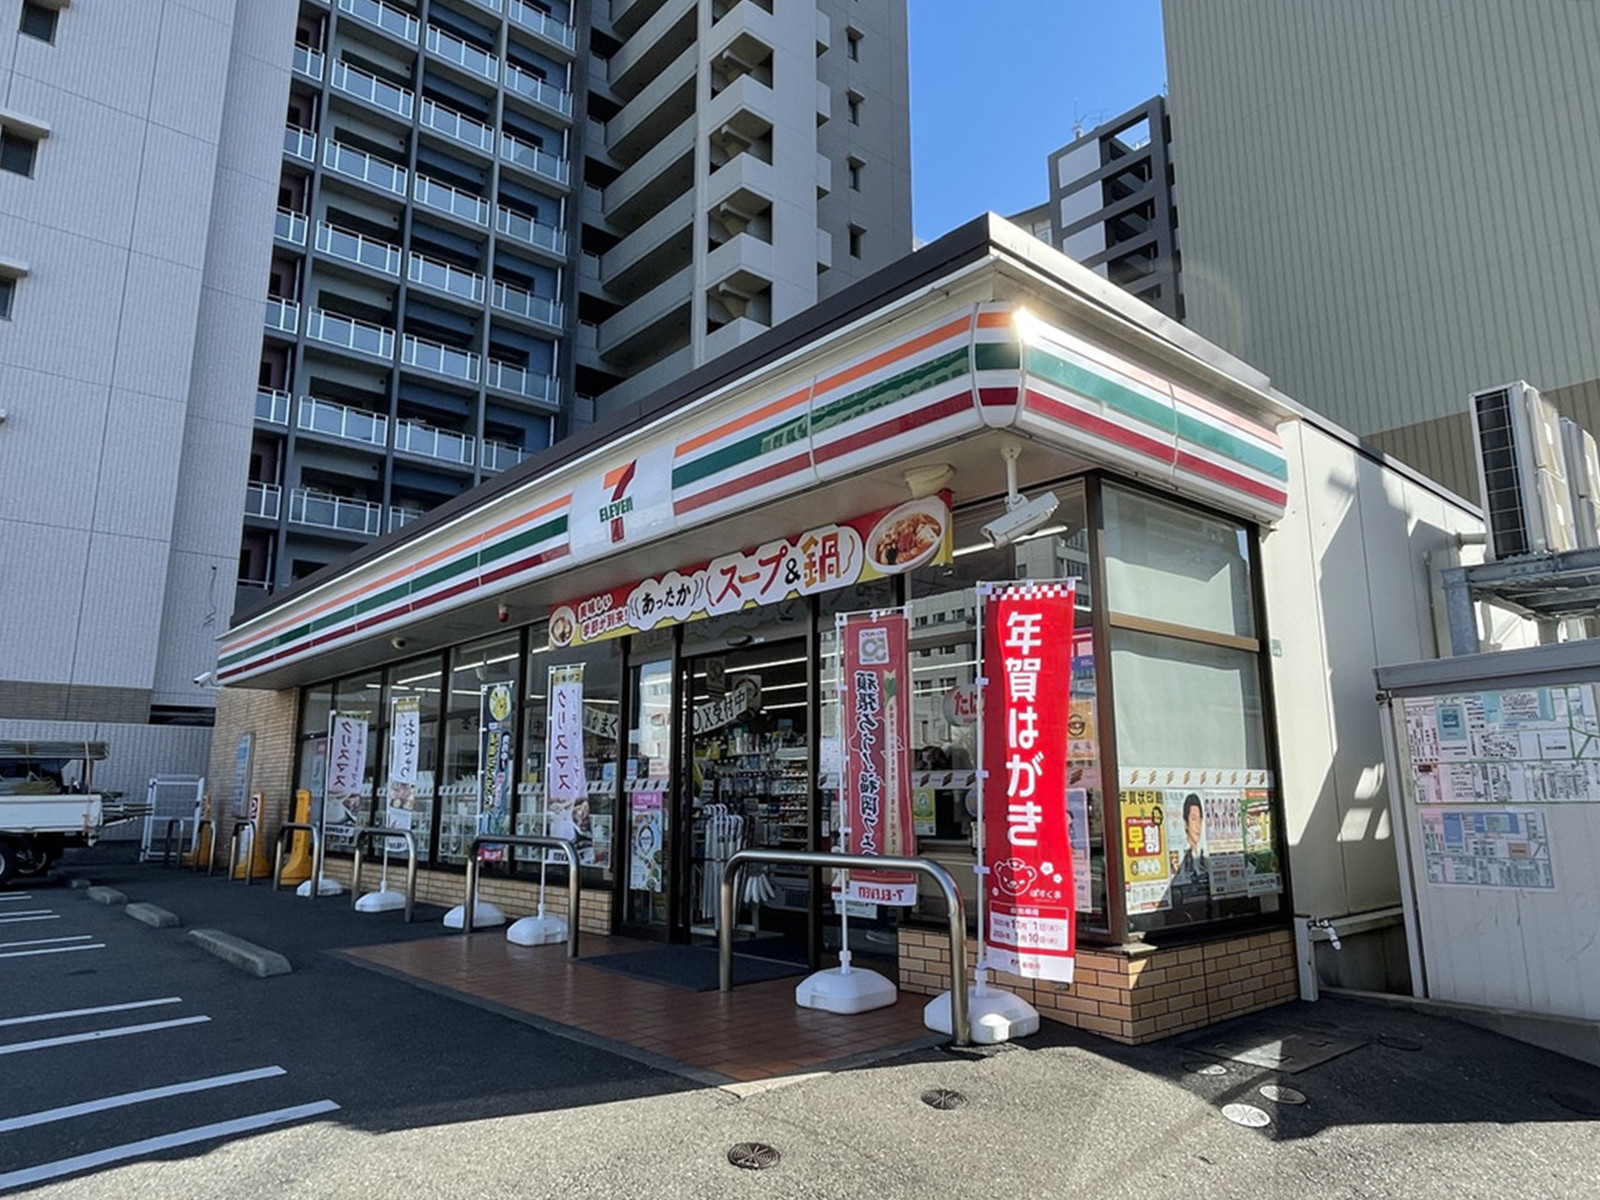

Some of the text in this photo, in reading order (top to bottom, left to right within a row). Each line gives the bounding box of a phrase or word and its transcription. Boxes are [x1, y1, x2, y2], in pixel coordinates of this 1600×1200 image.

[603, 459, 638, 543] 7
[641, 532, 841, 616] あったか スープ&鍋
[1004, 611, 1044, 847] 年賀はがき
